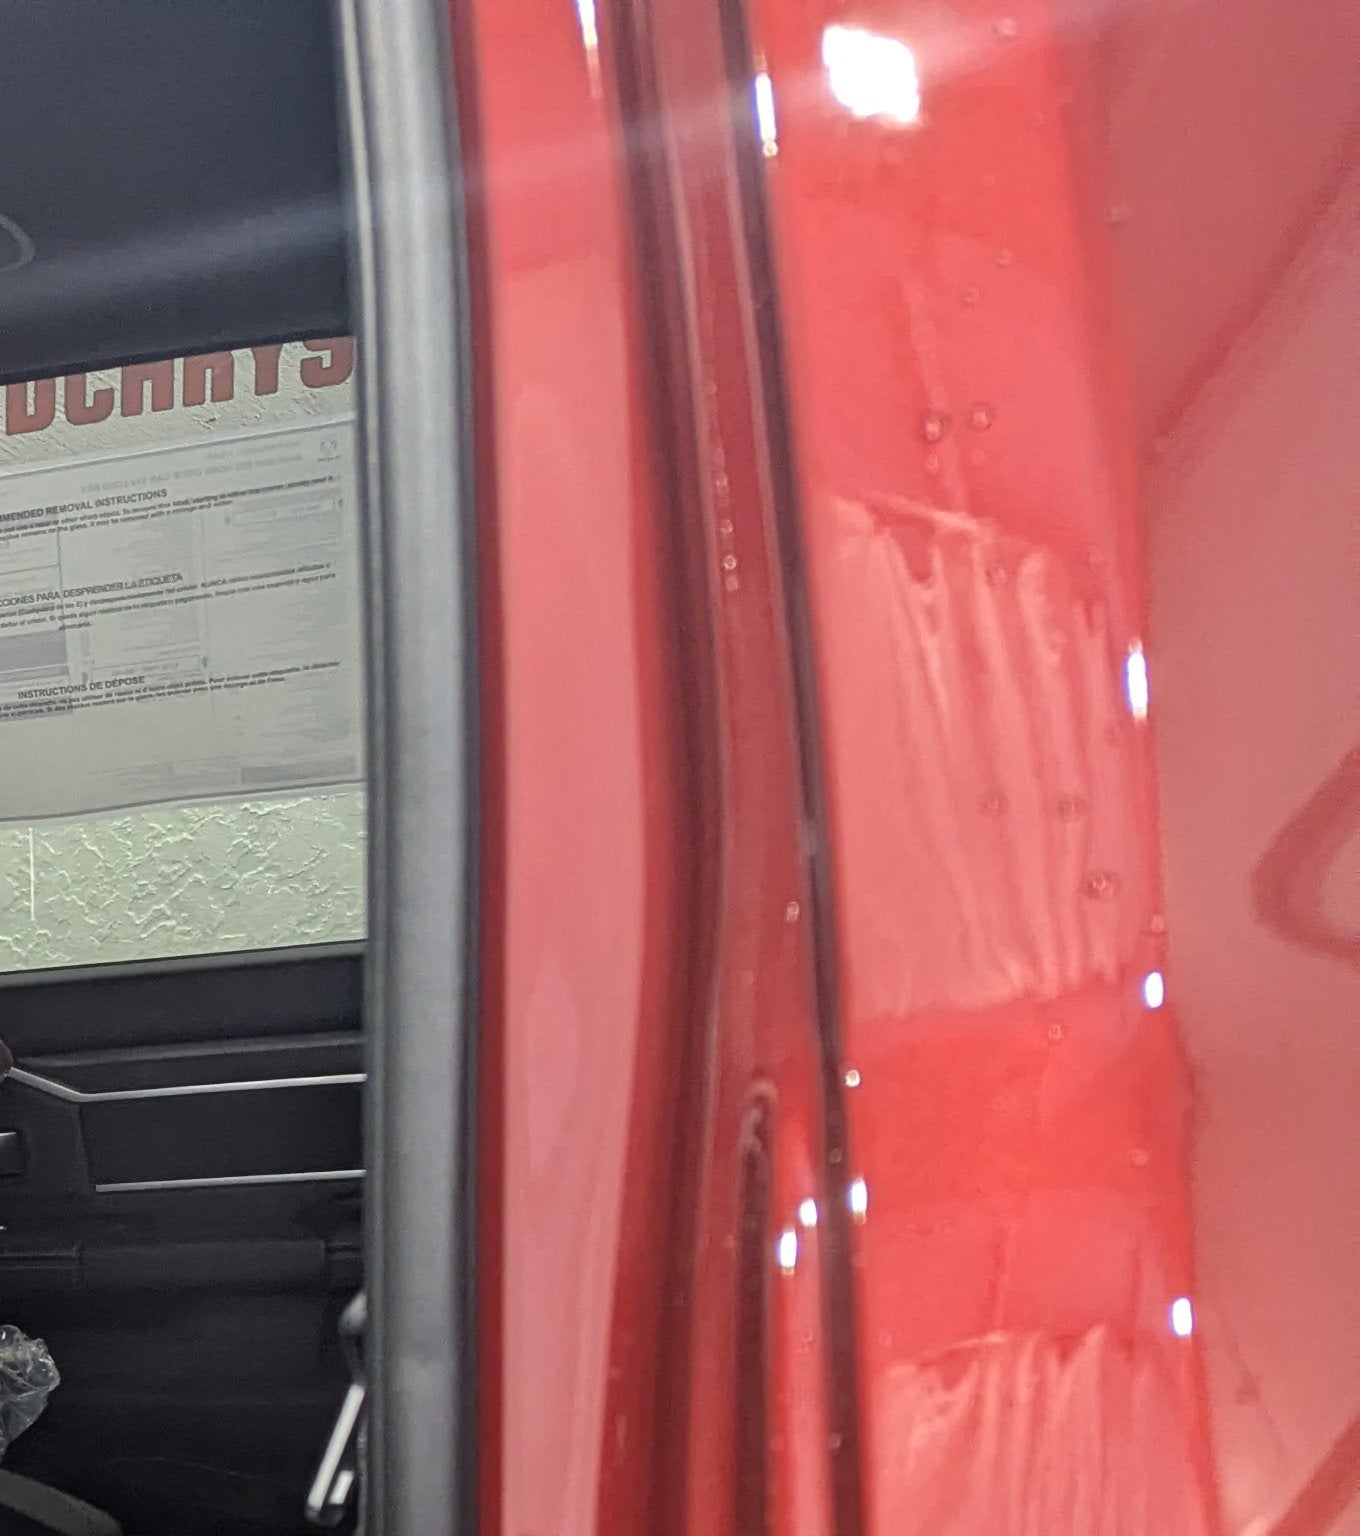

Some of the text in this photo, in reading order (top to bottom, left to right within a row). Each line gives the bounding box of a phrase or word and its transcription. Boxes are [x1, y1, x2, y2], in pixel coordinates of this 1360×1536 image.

[45, 499, 93, 517] REMOVAL
[94, 487, 168, 508] INSTRUCTIONS
[36, 591, 61, 603] PARA
[63, 581, 124, 598] DESPRENDER
[124, 579, 138, 590] LA
[138, 572, 183, 589] ETIQUETA
[17, 682, 88, 700] INSTRUCTIONS
[89, 680, 103, 691] DE
